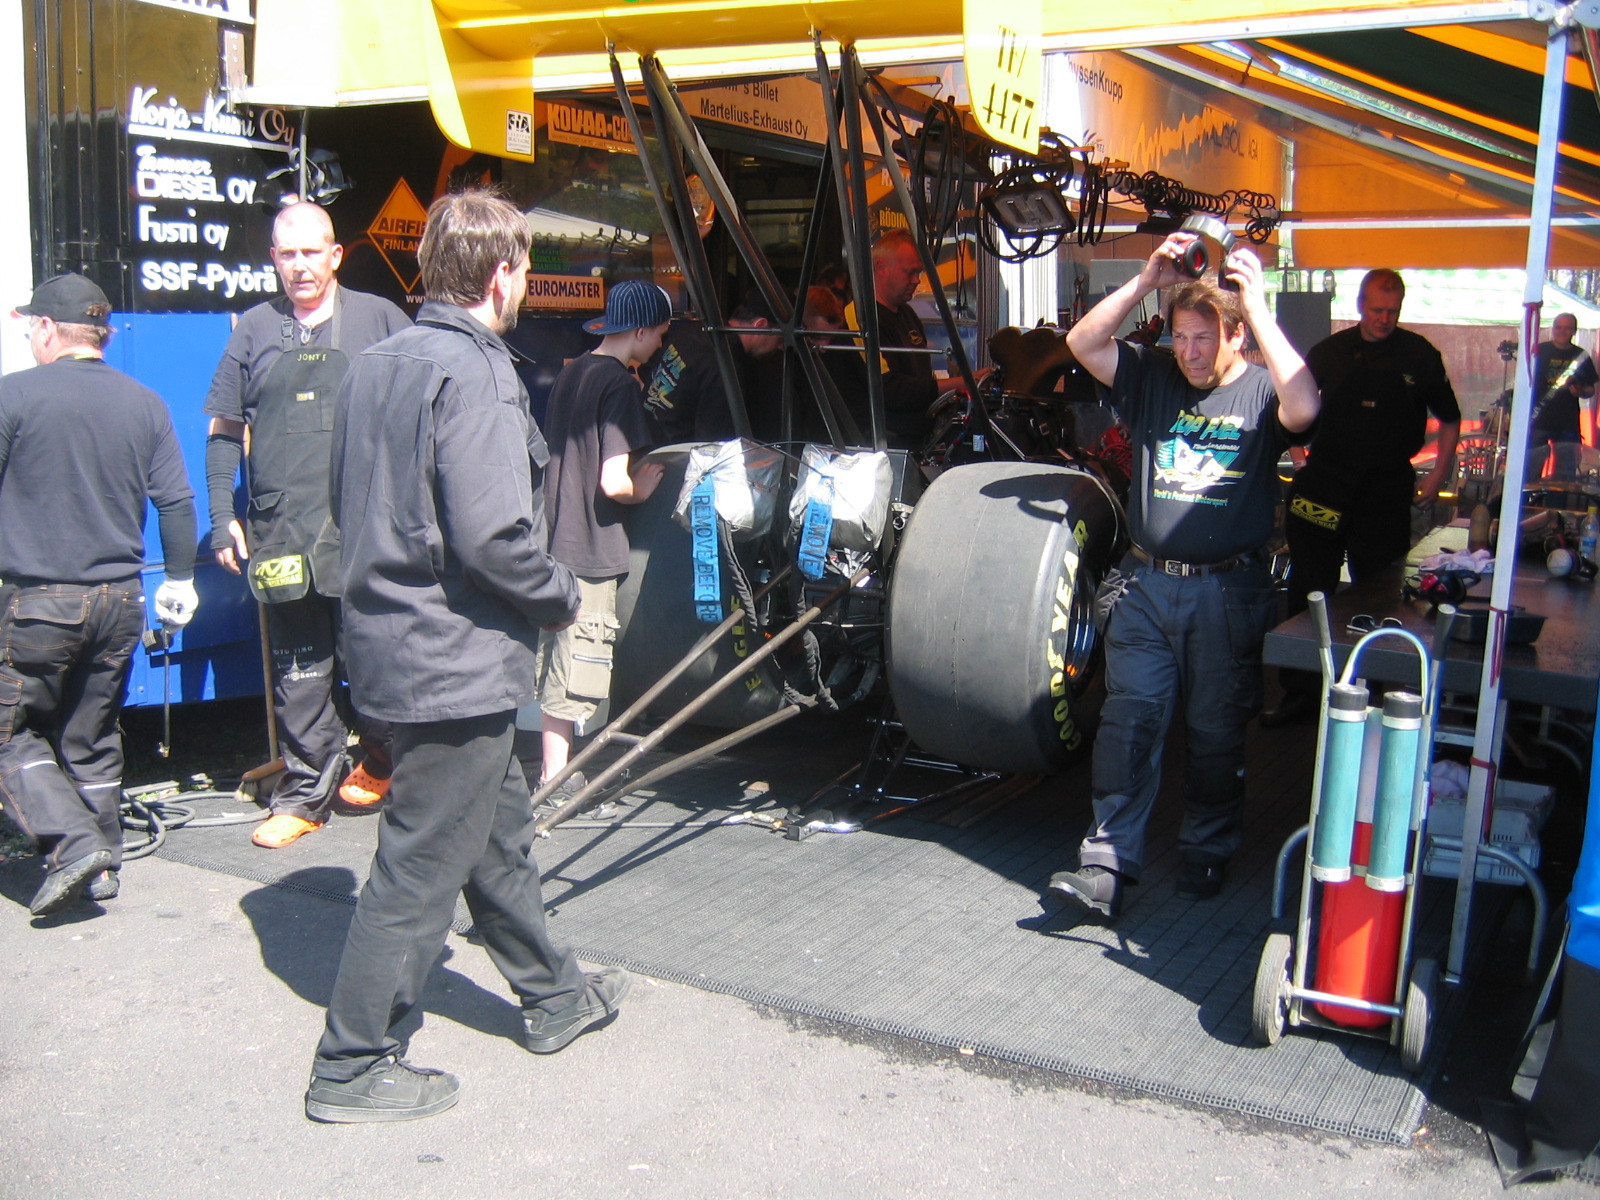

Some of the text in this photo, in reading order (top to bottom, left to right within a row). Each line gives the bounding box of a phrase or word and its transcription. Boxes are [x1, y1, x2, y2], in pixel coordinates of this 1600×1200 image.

[752, 81, 779, 102] Billet
[700, 97, 808, 140] Martelius-Exhaust Oy
[136, 170, 257, 205] DIESEL OY
[141, 260, 279, 298] SSF-Pyörä
[528, 279, 600, 299] EUROMASTER
[694, 494, 713, 559] REMOVE
